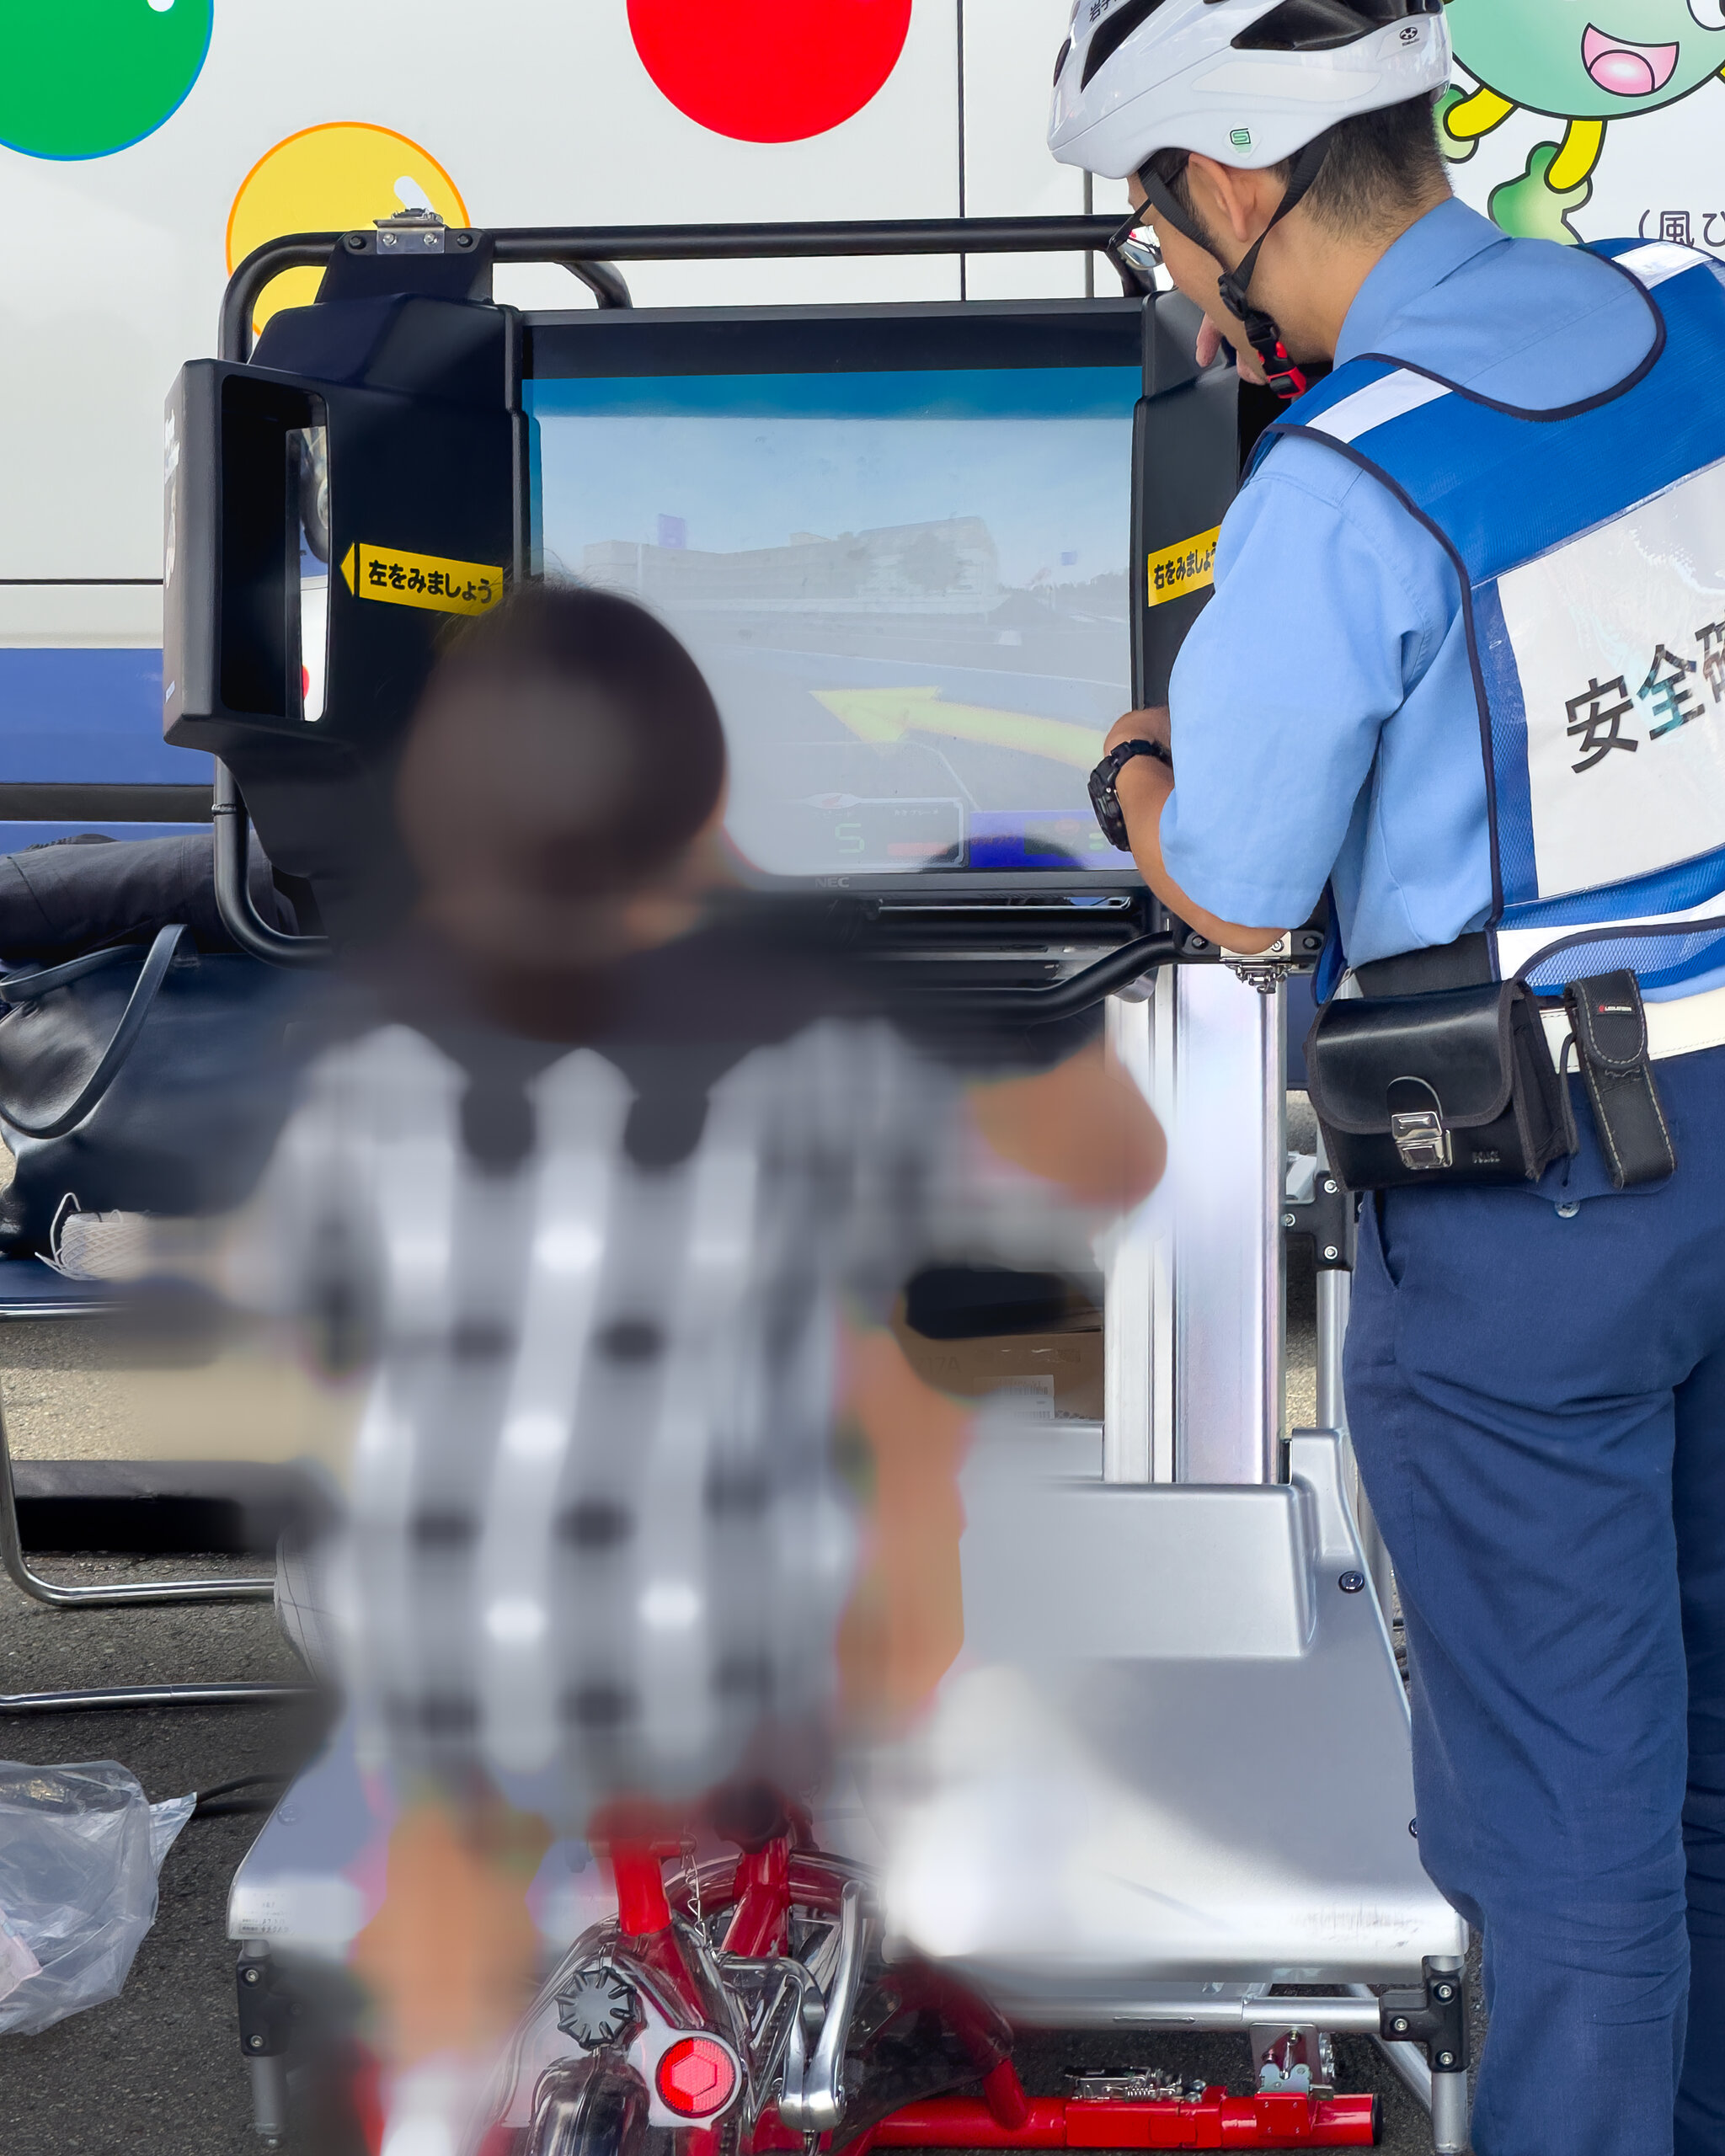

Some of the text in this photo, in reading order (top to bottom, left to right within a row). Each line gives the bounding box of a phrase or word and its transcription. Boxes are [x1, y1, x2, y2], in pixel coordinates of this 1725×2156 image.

[369, 559, 492, 604] 左をみましょう
[814, 877, 850, 889] NEC
